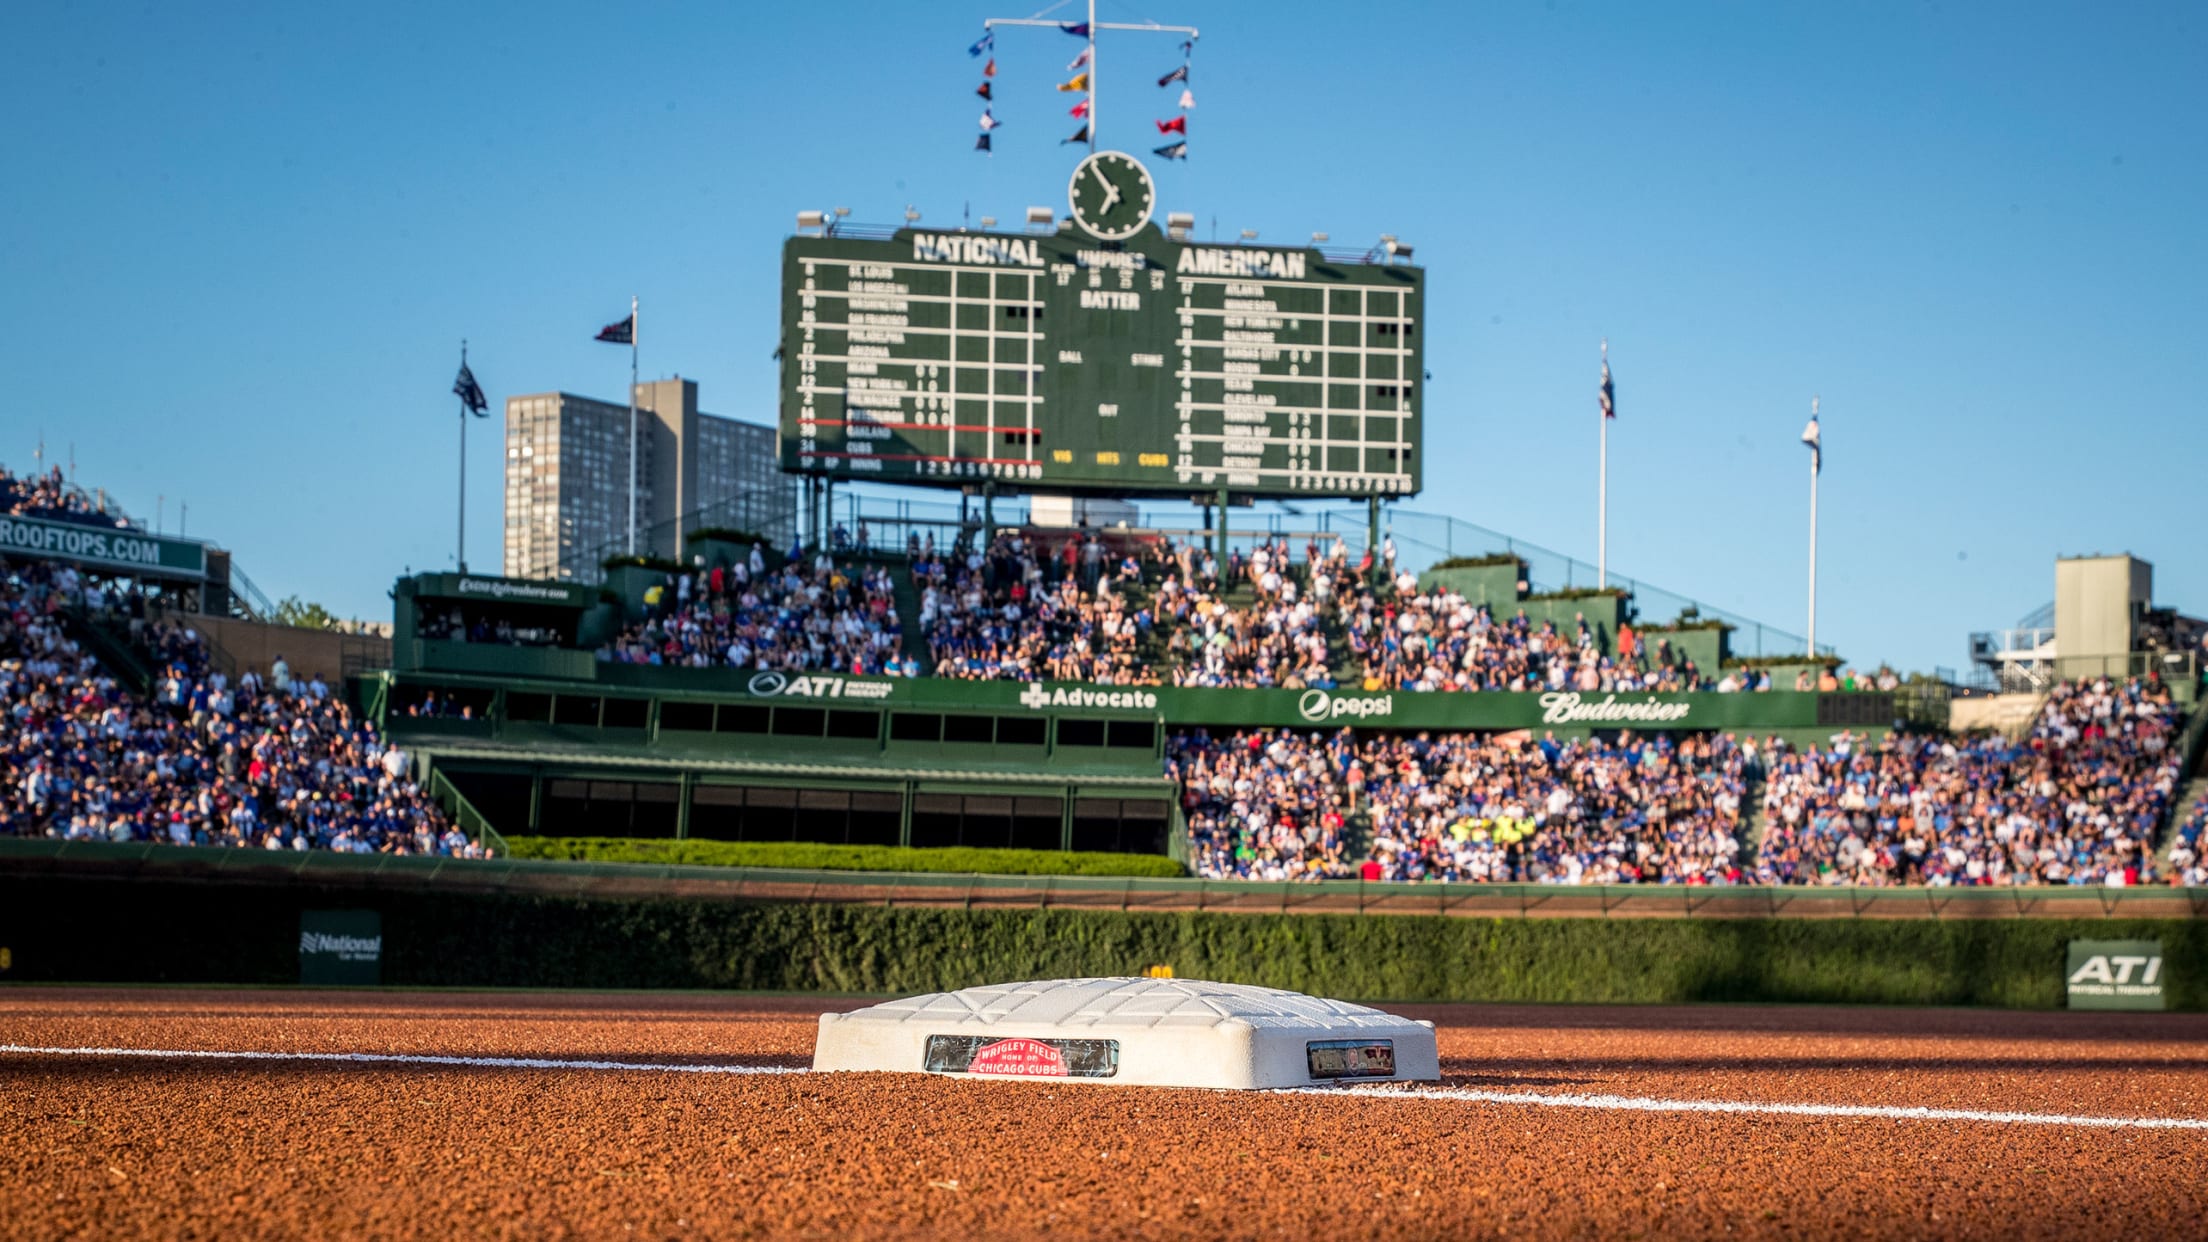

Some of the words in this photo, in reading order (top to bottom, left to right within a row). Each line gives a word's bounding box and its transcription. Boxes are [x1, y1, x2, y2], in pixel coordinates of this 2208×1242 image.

[913, 233, 1045, 267] NATIONAL
[1176, 247, 1306, 279] AMERICAN
[1081, 290, 1140, 311] BATTER
[1059, 350, 1082, 364] BALL
[1098, 403, 1118, 417] OUT
[916, 460, 922, 474] 1
[928, 460, 937, 475] 2
[942, 461, 951, 475] 3
[953, 462, 962, 476] 4
[967, 462, 976, 476] 5
[979, 462, 989, 477] 6
[993, 463, 1002, 478] 7
[1005, 463, 1015, 478] 8
[1018, 463, 1028, 479] 9
[1029, 464, 1043, 480] 10
[1290, 474, 1296, 489] 1
[1301, 474, 1310, 490] 2
[1314, 475, 1323, 490] 3
[1325, 476, 1335, 491] 4
[1338, 476, 1348, 491] 5
[1350, 477, 1360, 491] 6
[1363, 477, 1372, 492] 7
[1375, 477, 1386, 493] 8
[1387, 478, 1398, 493] 9
[1399, 478, 1413, 494] 10
[0, 519, 160, 564] ROOFTOPS.COM
[784, 676, 844, 698] ATI
[1052, 687, 1157, 709] Advocate
[1331, 694, 1392, 719] pepsi
[1538, 692, 1690, 724] Budweiser
[319, 934, 382, 953] National
[2069, 955, 2163, 985] ATI
[981, 1041, 1026, 1060] WRIGLEY
[1029, 1042, 1057, 1061] FIELD
[979, 1063, 1025, 1074] CHICAGO
[1028, 1064, 1058, 1075] CUBS
